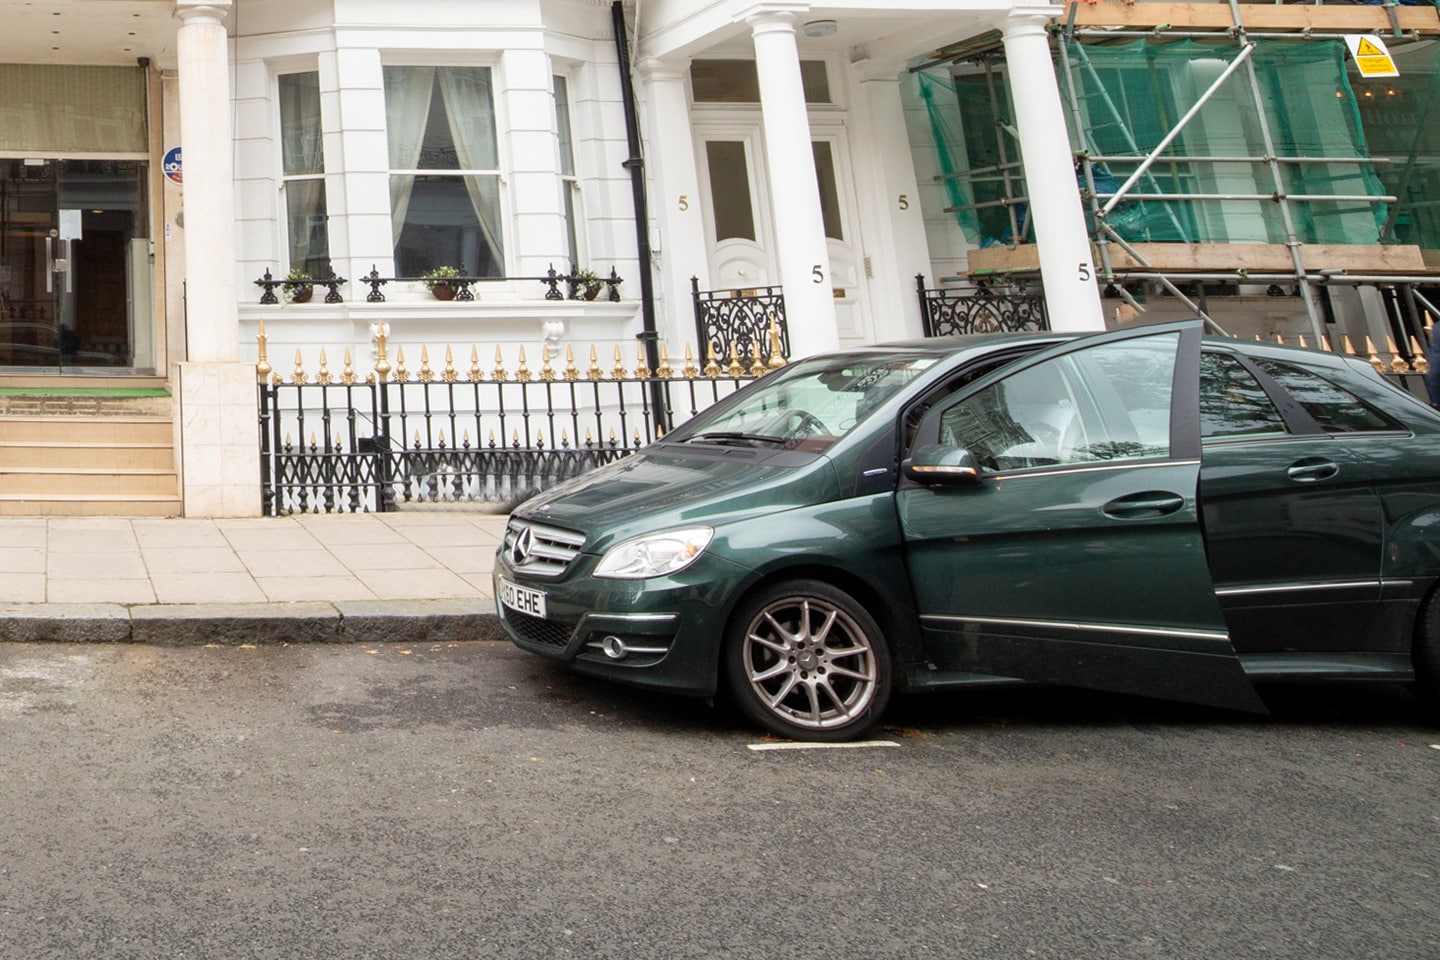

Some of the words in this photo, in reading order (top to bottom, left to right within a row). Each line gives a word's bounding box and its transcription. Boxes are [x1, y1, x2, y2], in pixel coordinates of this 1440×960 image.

[678, 195, 688, 211] 5
[898, 194, 908, 211] 5
[812, 264, 824, 284] 5
[1078, 263, 1090, 281] 5
[517, 589, 540, 614] EHE
